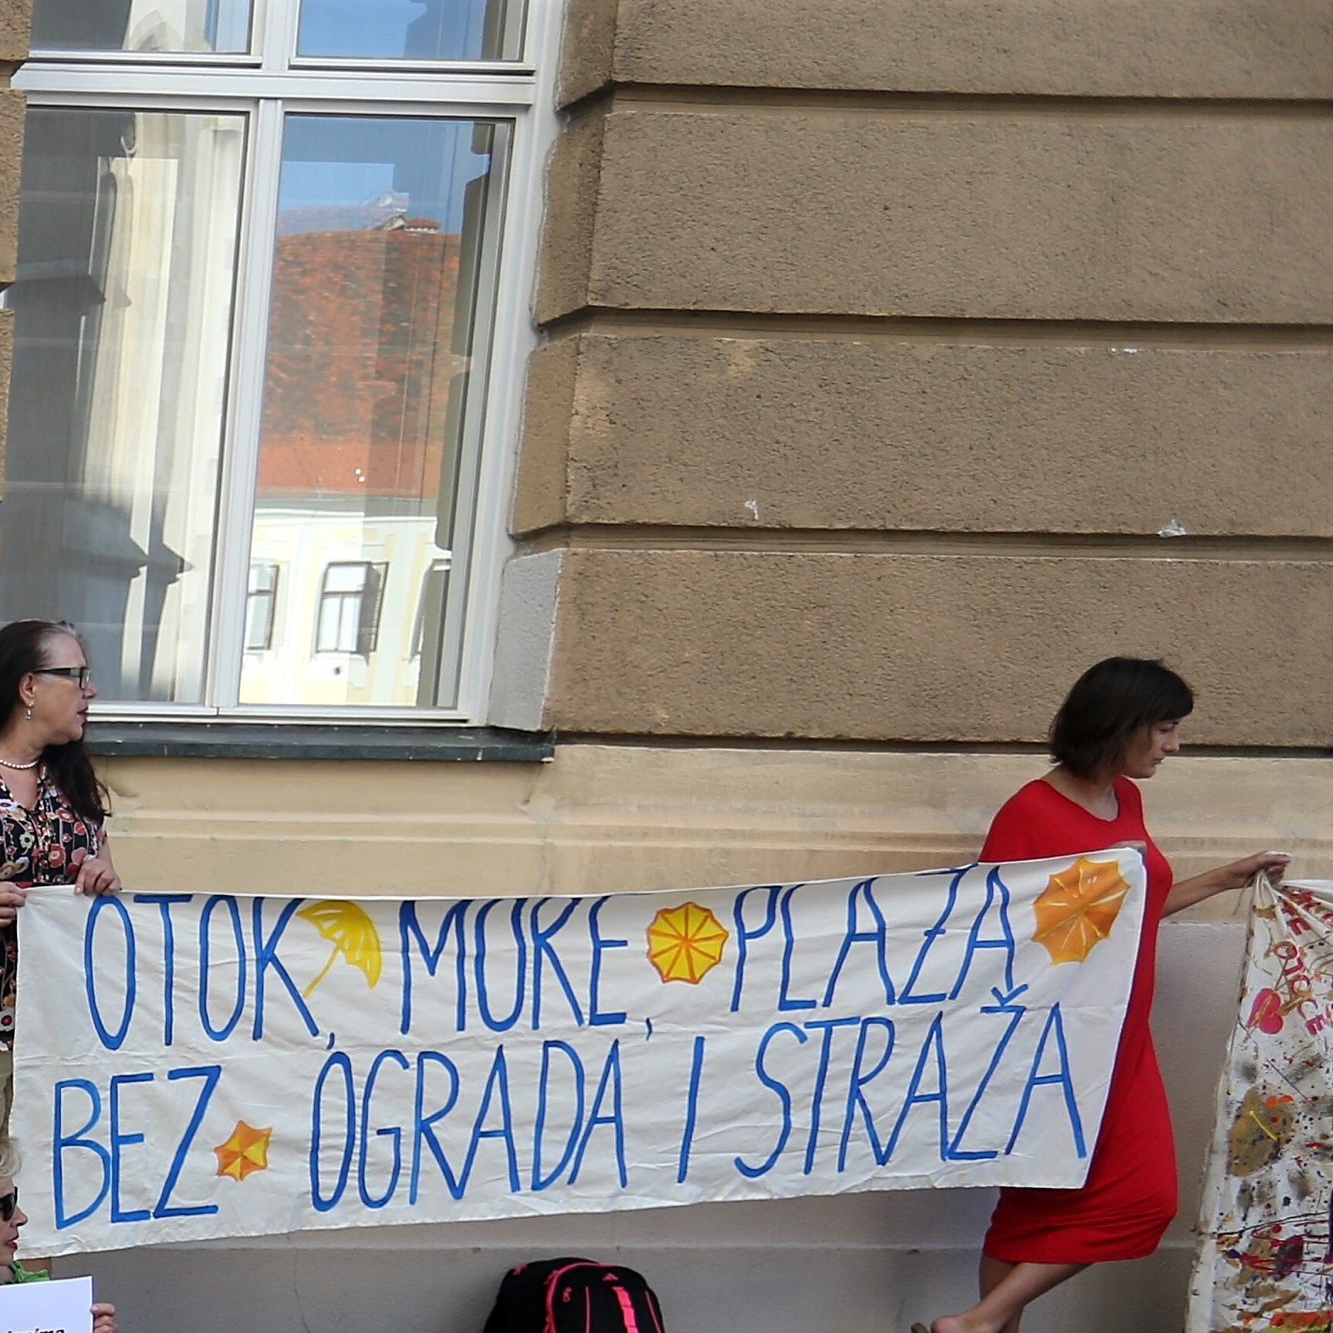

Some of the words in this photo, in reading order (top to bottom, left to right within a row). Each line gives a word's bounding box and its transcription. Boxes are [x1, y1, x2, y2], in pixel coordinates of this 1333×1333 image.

[53, 1064, 222, 1230] BEZ
[308, 1038, 627, 1212] OGRADA
[677, 1036, 705, 1183] I
[733, 983, 1087, 1179] STRAŽA
